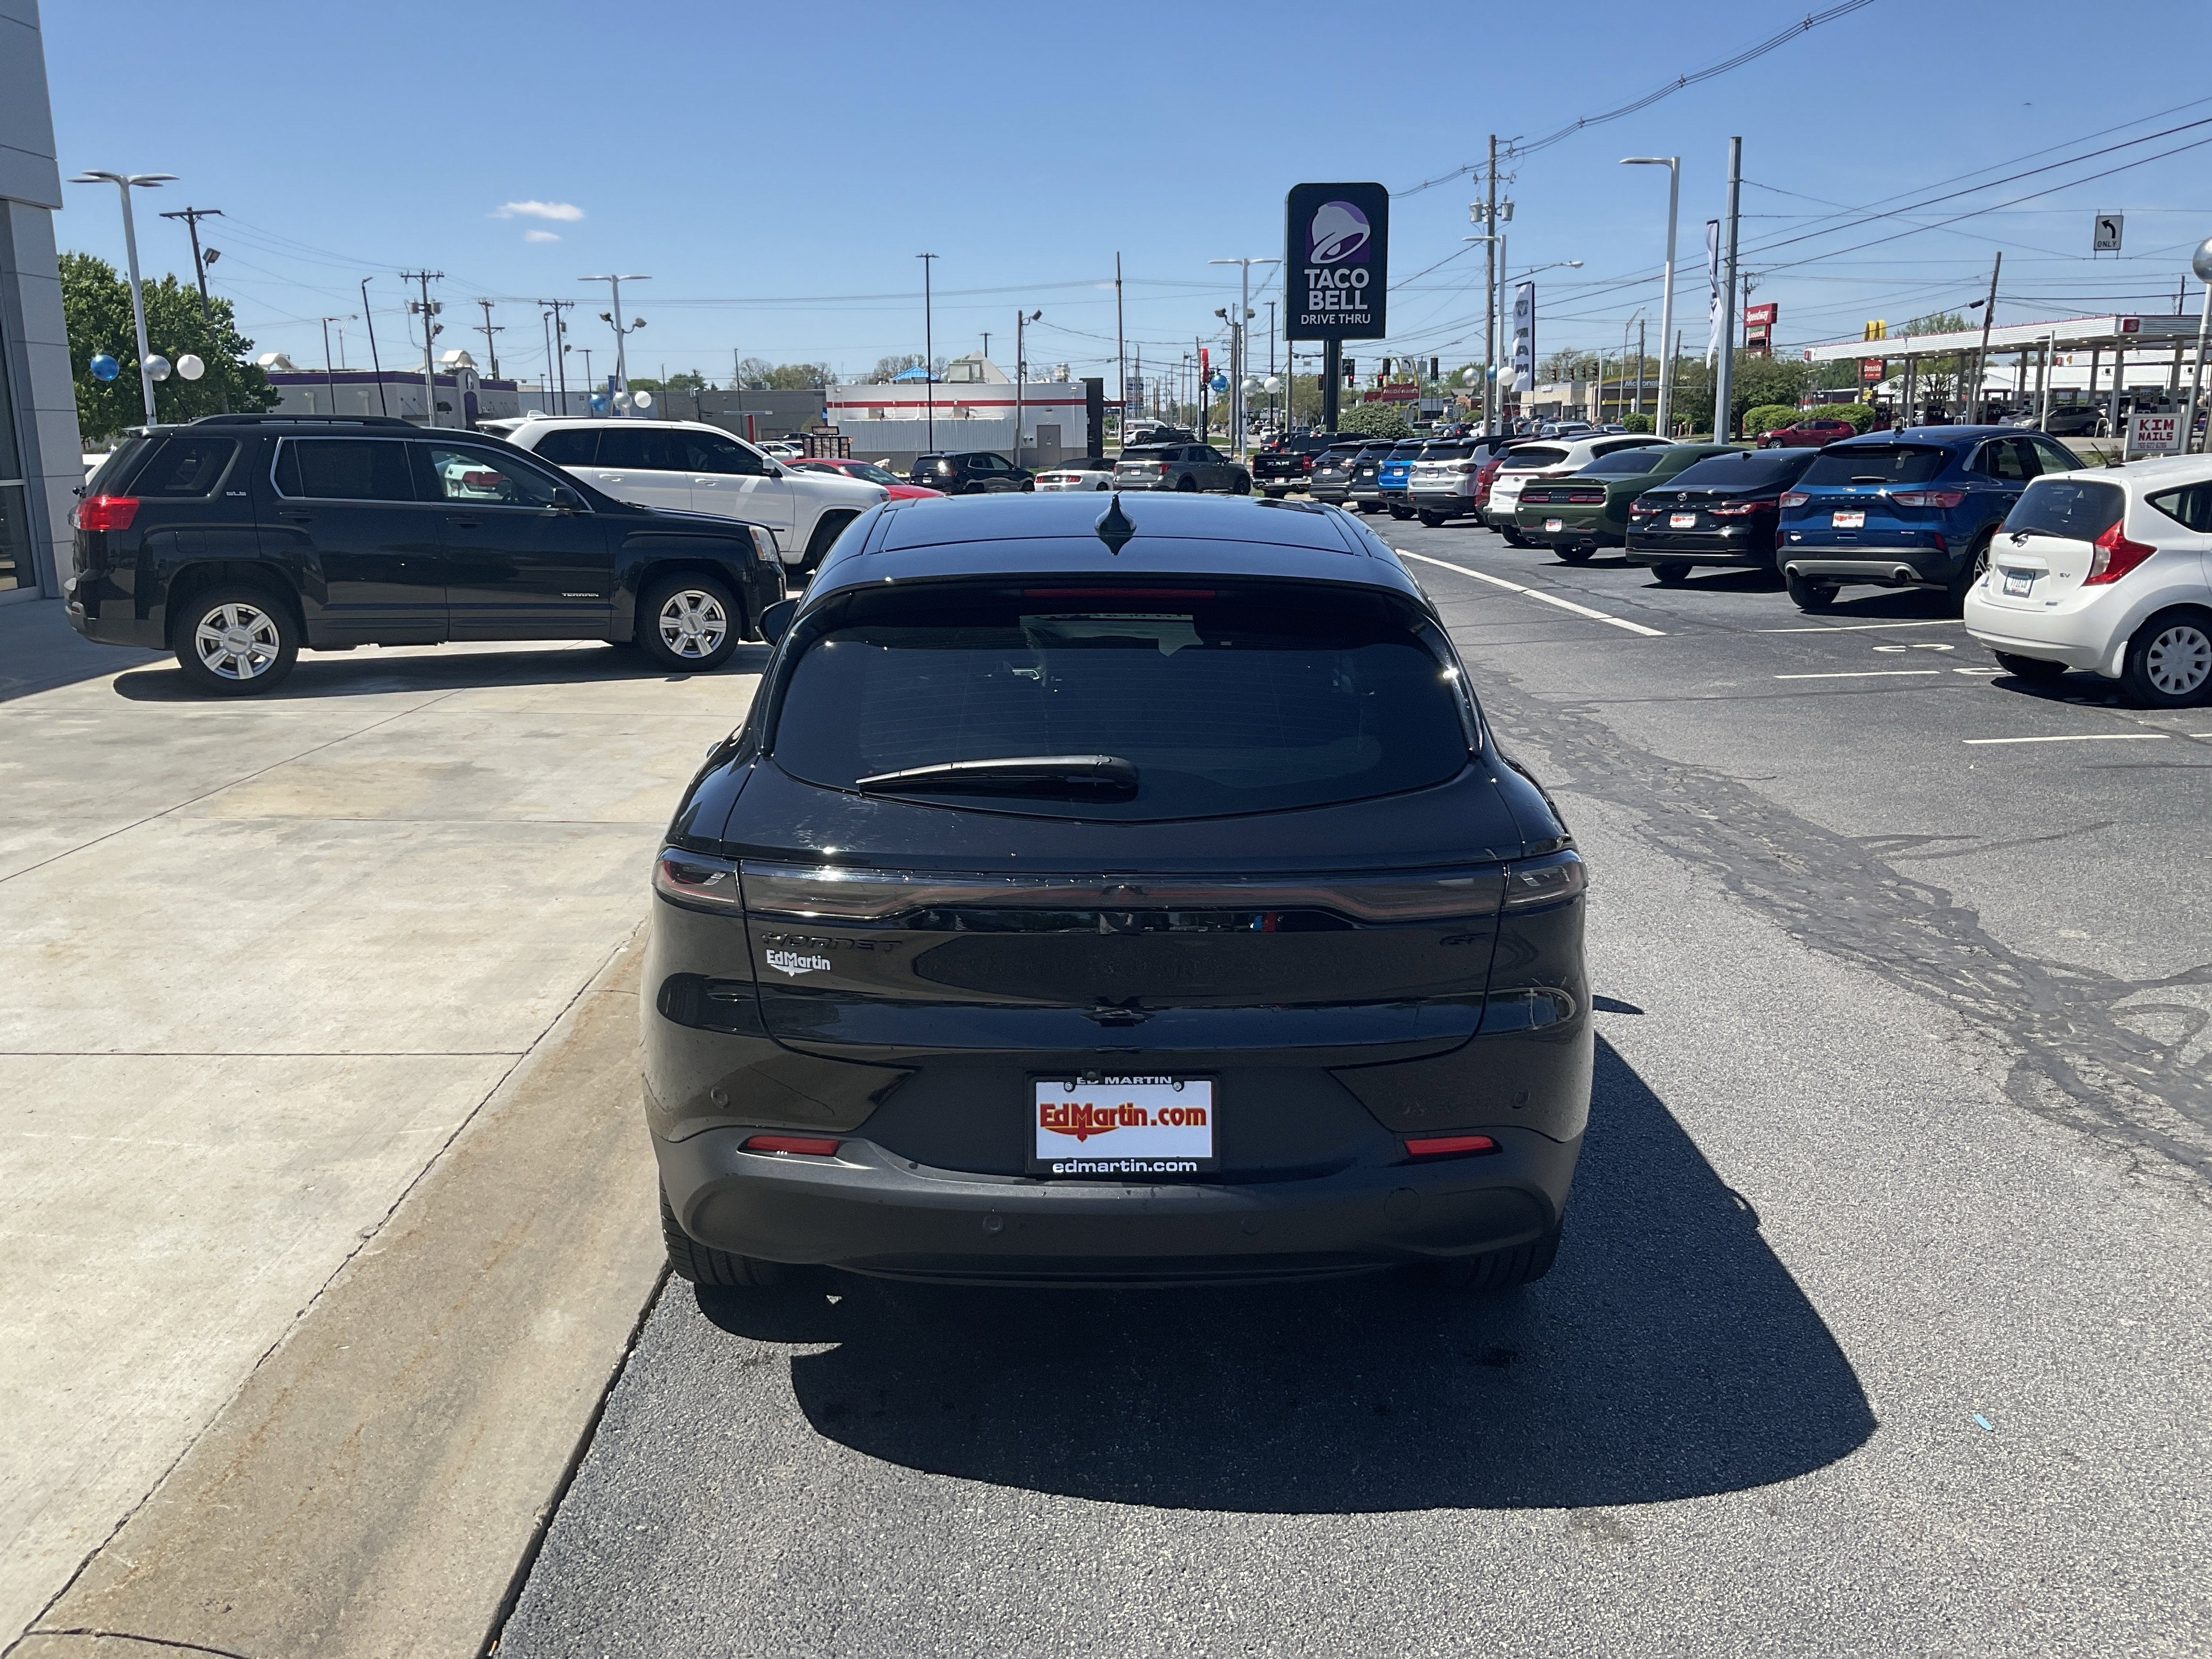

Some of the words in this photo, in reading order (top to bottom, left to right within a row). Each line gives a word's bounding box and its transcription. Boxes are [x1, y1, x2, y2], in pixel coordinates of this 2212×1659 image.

[1304, 268, 1369, 289] TACO
[1308, 290, 1368, 311] BELL
[1301, 314, 1335, 325] DRIVE
[1339, 314, 1370, 324] THRU
[1746, 309, 1769, 324] Speedway
[2139, 419, 2175, 431] KIM
[2138, 432, 2173, 441] NAILS
[766, 949, 831, 971] EdMartin
[1040, 1102, 1206, 1128] EdMartin.com
[1052, 1159, 1197, 1173] edmartin.com
